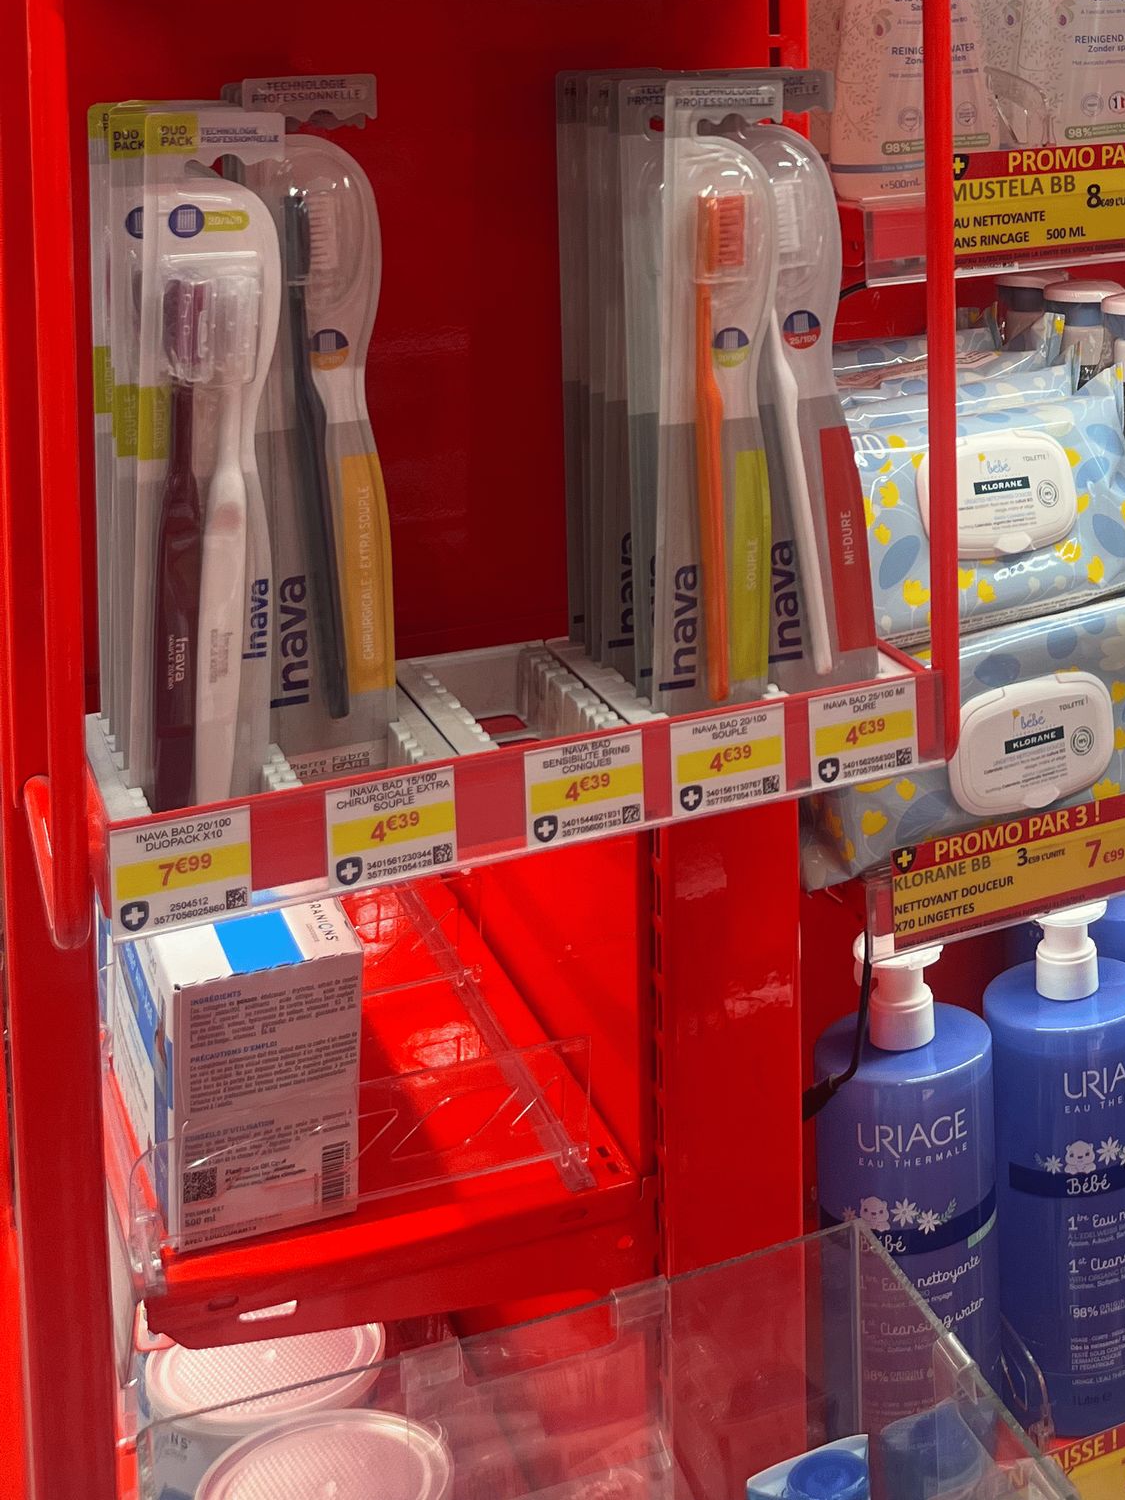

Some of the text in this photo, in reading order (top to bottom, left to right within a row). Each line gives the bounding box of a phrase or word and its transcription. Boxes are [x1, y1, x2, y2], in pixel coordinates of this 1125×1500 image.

[1075, 33, 1122, 44] REINIGEND
[161, 126, 187, 137] DUO
[161, 135, 193, 147] PACK
[1008, 146, 1097, 172] PROMO
[1050, 174, 1076, 194] BB
[973, 210, 1045, 228] NETTOYANTE
[987, 226, 1085, 245] RINCAGE 500 ML
[839, 509, 852, 566] MI-DURE
[242, 578, 268, 660] Inava
[659, 564, 699, 692] Inava
[270, 575, 309, 709] Inava
[1012, 732, 1056, 750] KLORANE
[566, 772, 610, 802] 4€39
[136, 817, 231, 843] INAVA BAD 20/100
[371, 810, 420, 842] 4€39
[934, 806, 1088, 862] PROMO PAR 3
[145, 829, 222, 852] DUOPACK X10
[158, 853, 212, 886] 7€99
[894, 854, 990, 892] KLORANE BB
[894, 876, 1014, 914] NETTOYANT DOUCEUR
[857, 1109, 967, 1156] URIAGE
[1066, 1174, 1111, 1196] Bébé
